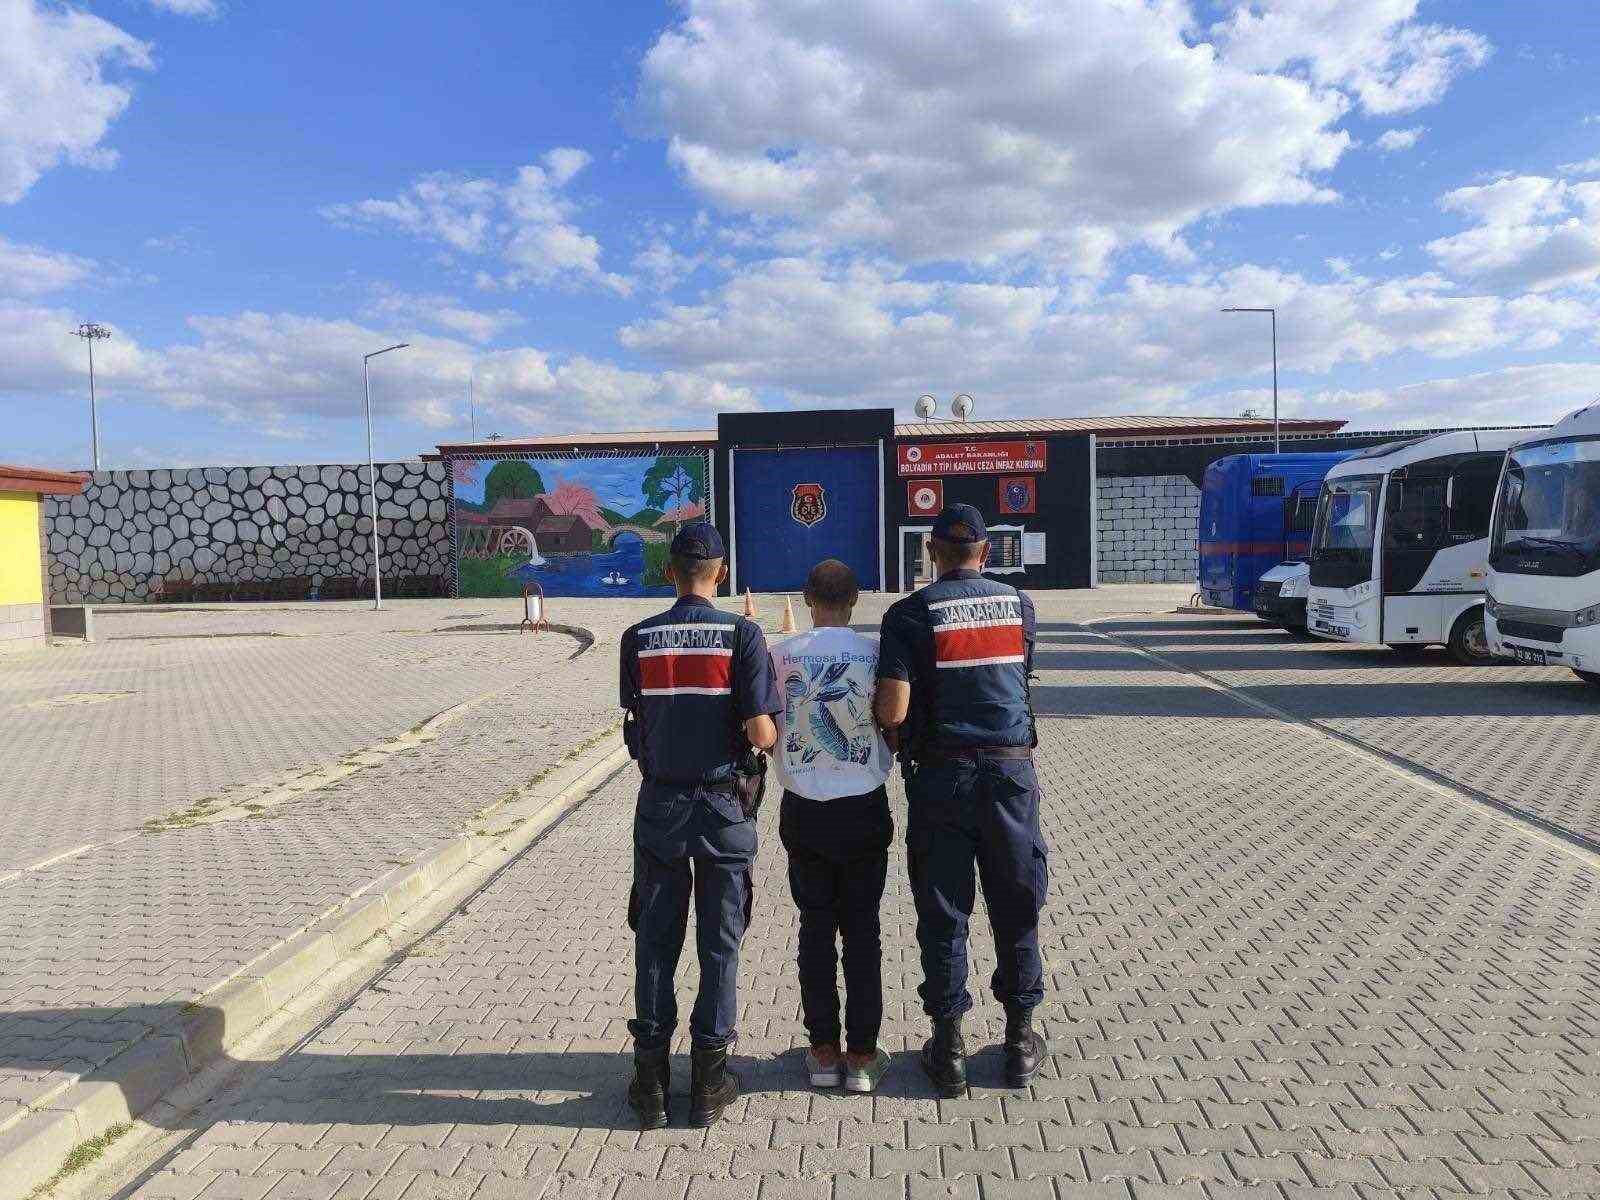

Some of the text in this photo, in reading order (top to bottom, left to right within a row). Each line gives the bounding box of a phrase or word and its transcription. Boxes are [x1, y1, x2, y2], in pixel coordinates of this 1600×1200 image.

[954, 461, 976, 471] KAPALI
[977, 460, 994, 471] CEZA
[1015, 459, 1044, 470] KURUMU
[943, 602, 1017, 624] JANDARMA
[645, 629, 724, 650] JANDARMA
[783, 650, 838, 664] Hermosa
